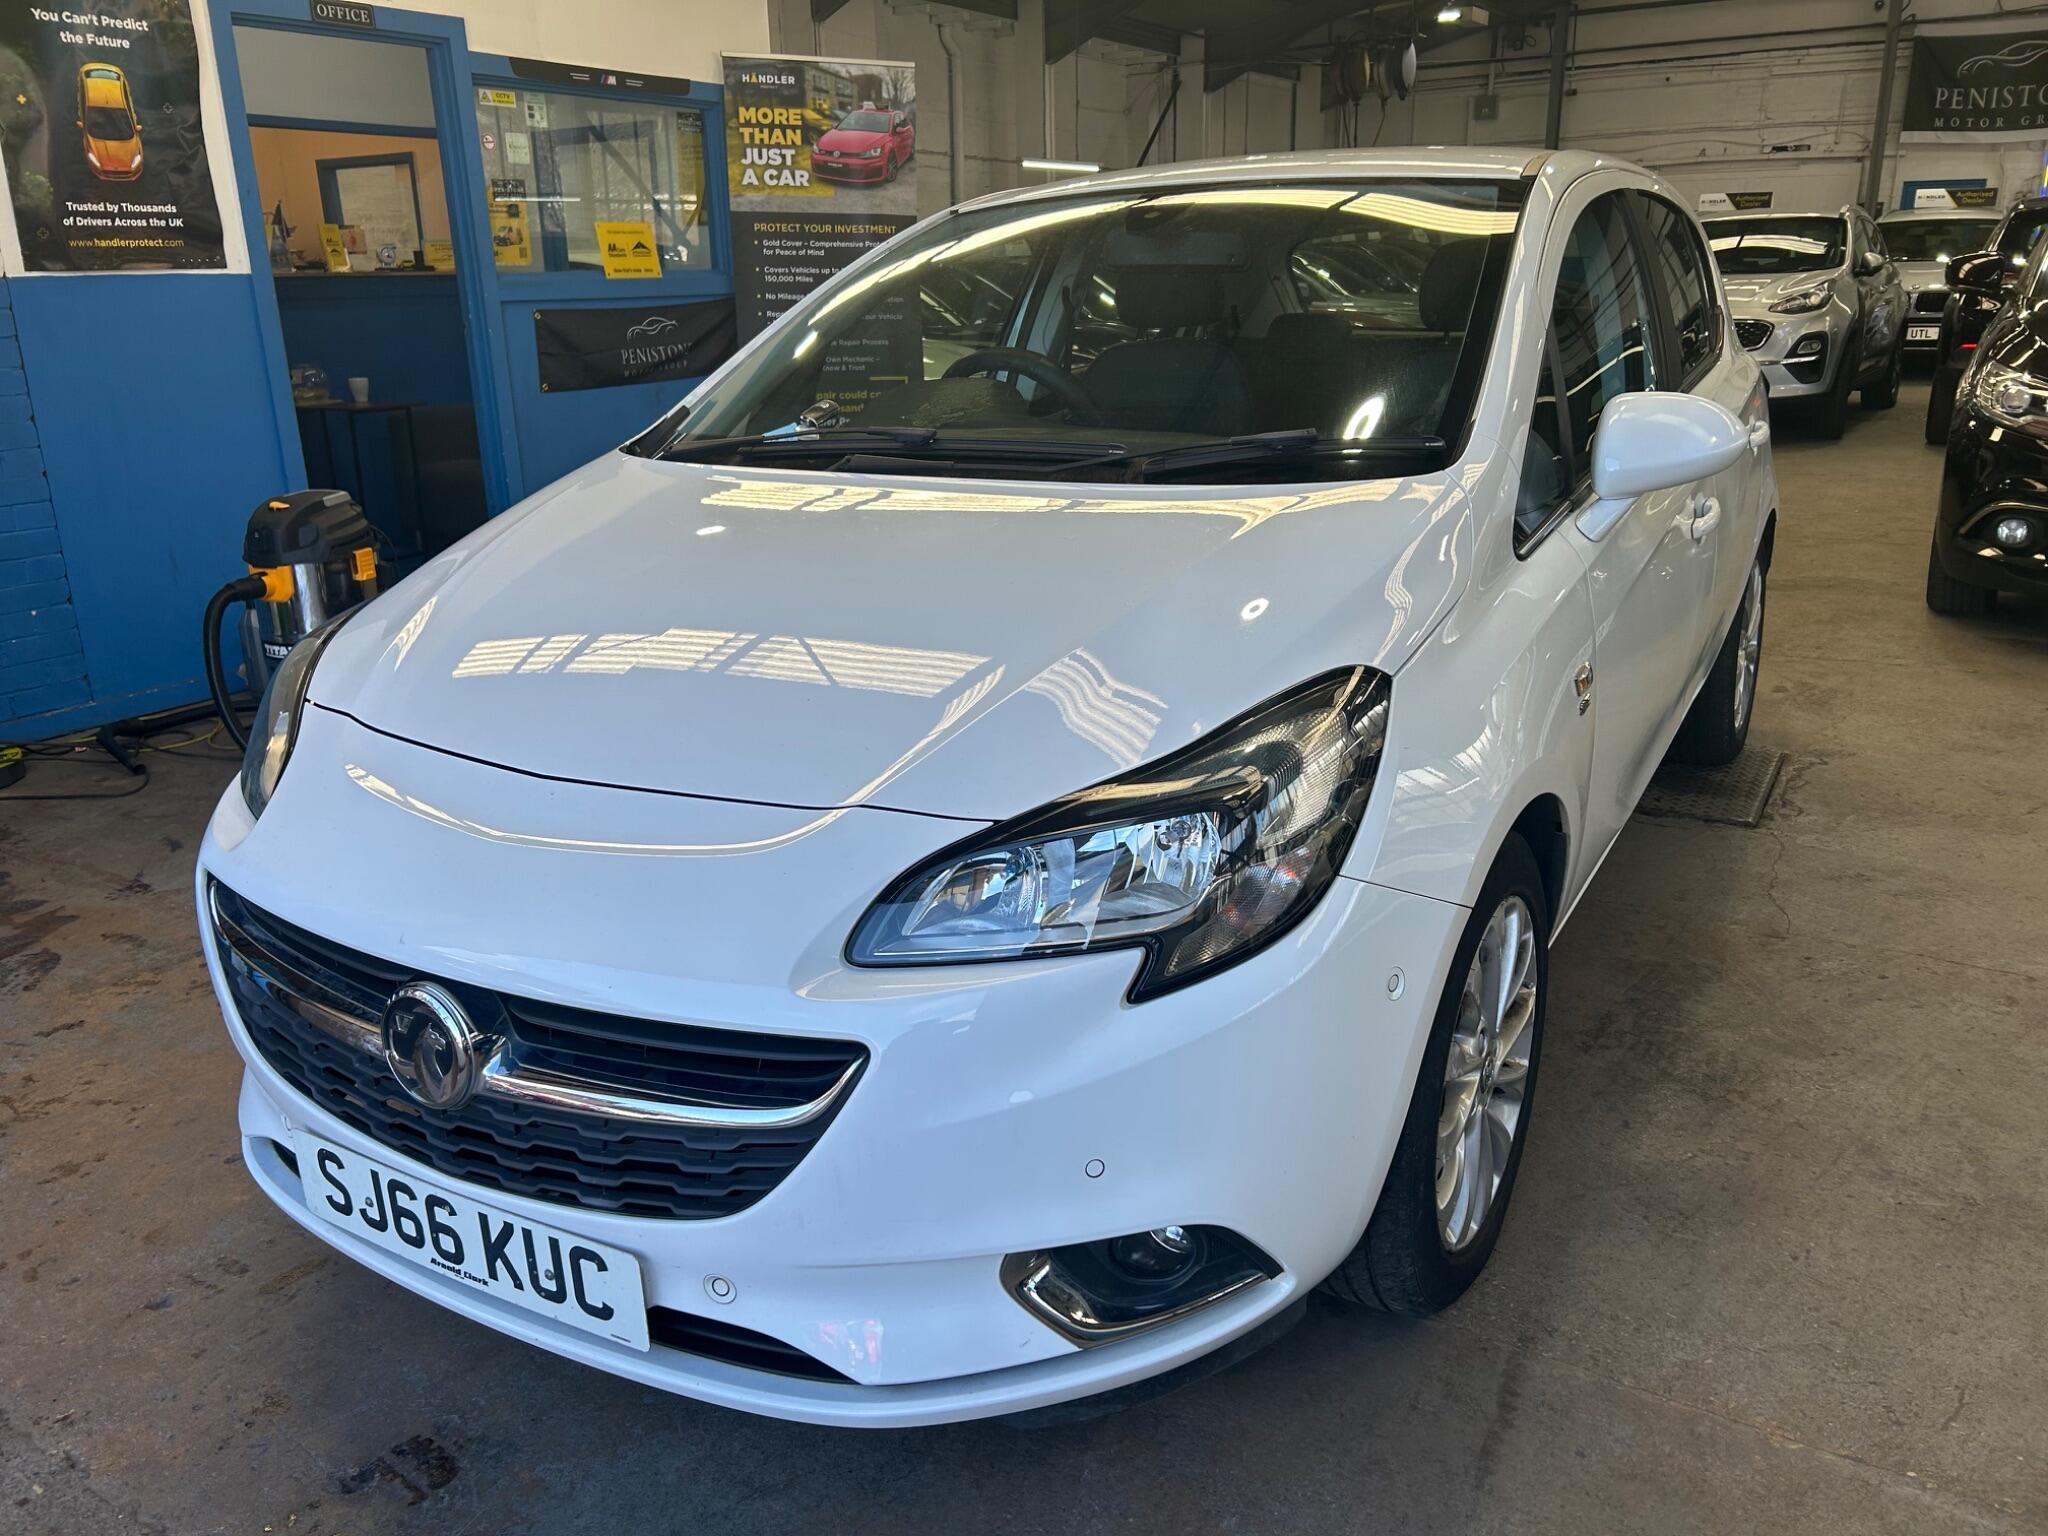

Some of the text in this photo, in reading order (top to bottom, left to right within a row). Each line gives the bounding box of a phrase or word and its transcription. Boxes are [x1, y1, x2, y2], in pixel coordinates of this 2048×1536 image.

[317, 3, 370, 22] OFFICE
[30, 8, 149, 31] You Can't Predict
[60, 31, 130, 49] the Future
[742, 72, 796, 85] HANDLER
[738, 107, 802, 125] MORE
[1934, 114, 2048, 128] MOTOR GR
[739, 128, 802, 145] THAN
[741, 148, 796, 166] JUST
[742, 169, 810, 187] A CAR
[66, 202, 177, 213] Trusted by Thousands
[63, 216, 184, 227] of Drivers Across the UK
[754, 223, 896, 234] PROTECT YOUR INVESTMENT
[69, 238, 184, 248] www.handlerprotect.com
[810, 240, 863, 249] Comprehensive
[764, 266, 788, 274] Covers
[821, 267, 830, 276] up
[765, 275, 813, 283] 150,000 Miles
[1911, 329, 1932, 338] UTL
[839, 389, 867, 400] could
[318, 1148, 614, 1321] SJ66 KUC
[430, 1257, 462, 1275] Arnold
[463, 1270, 489, 1287] Clark
